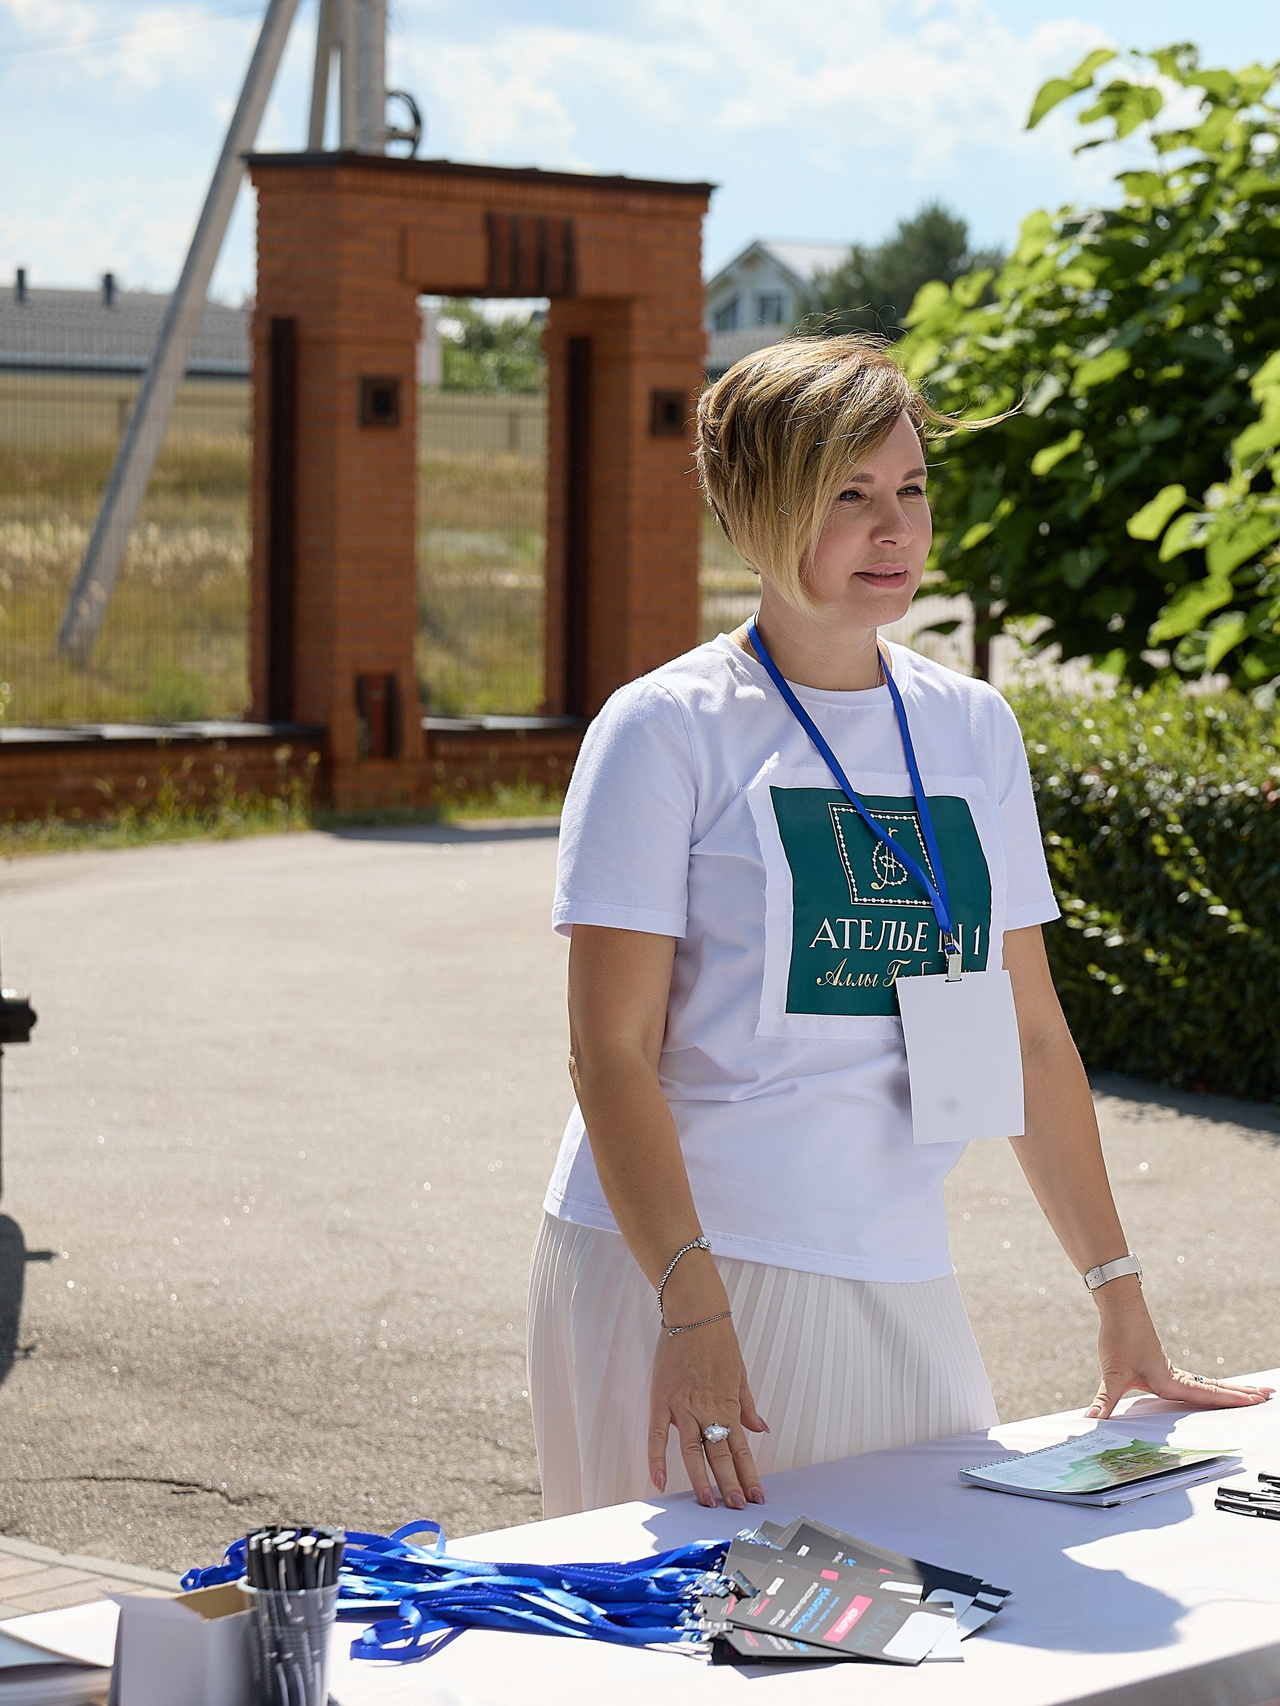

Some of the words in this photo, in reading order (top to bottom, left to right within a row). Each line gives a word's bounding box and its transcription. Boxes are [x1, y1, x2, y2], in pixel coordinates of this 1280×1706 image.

[809, 918, 929, 952] АТЕЛЬЕ
[973, 924, 981, 955] 1
[816, 957, 879, 988] Аллы
